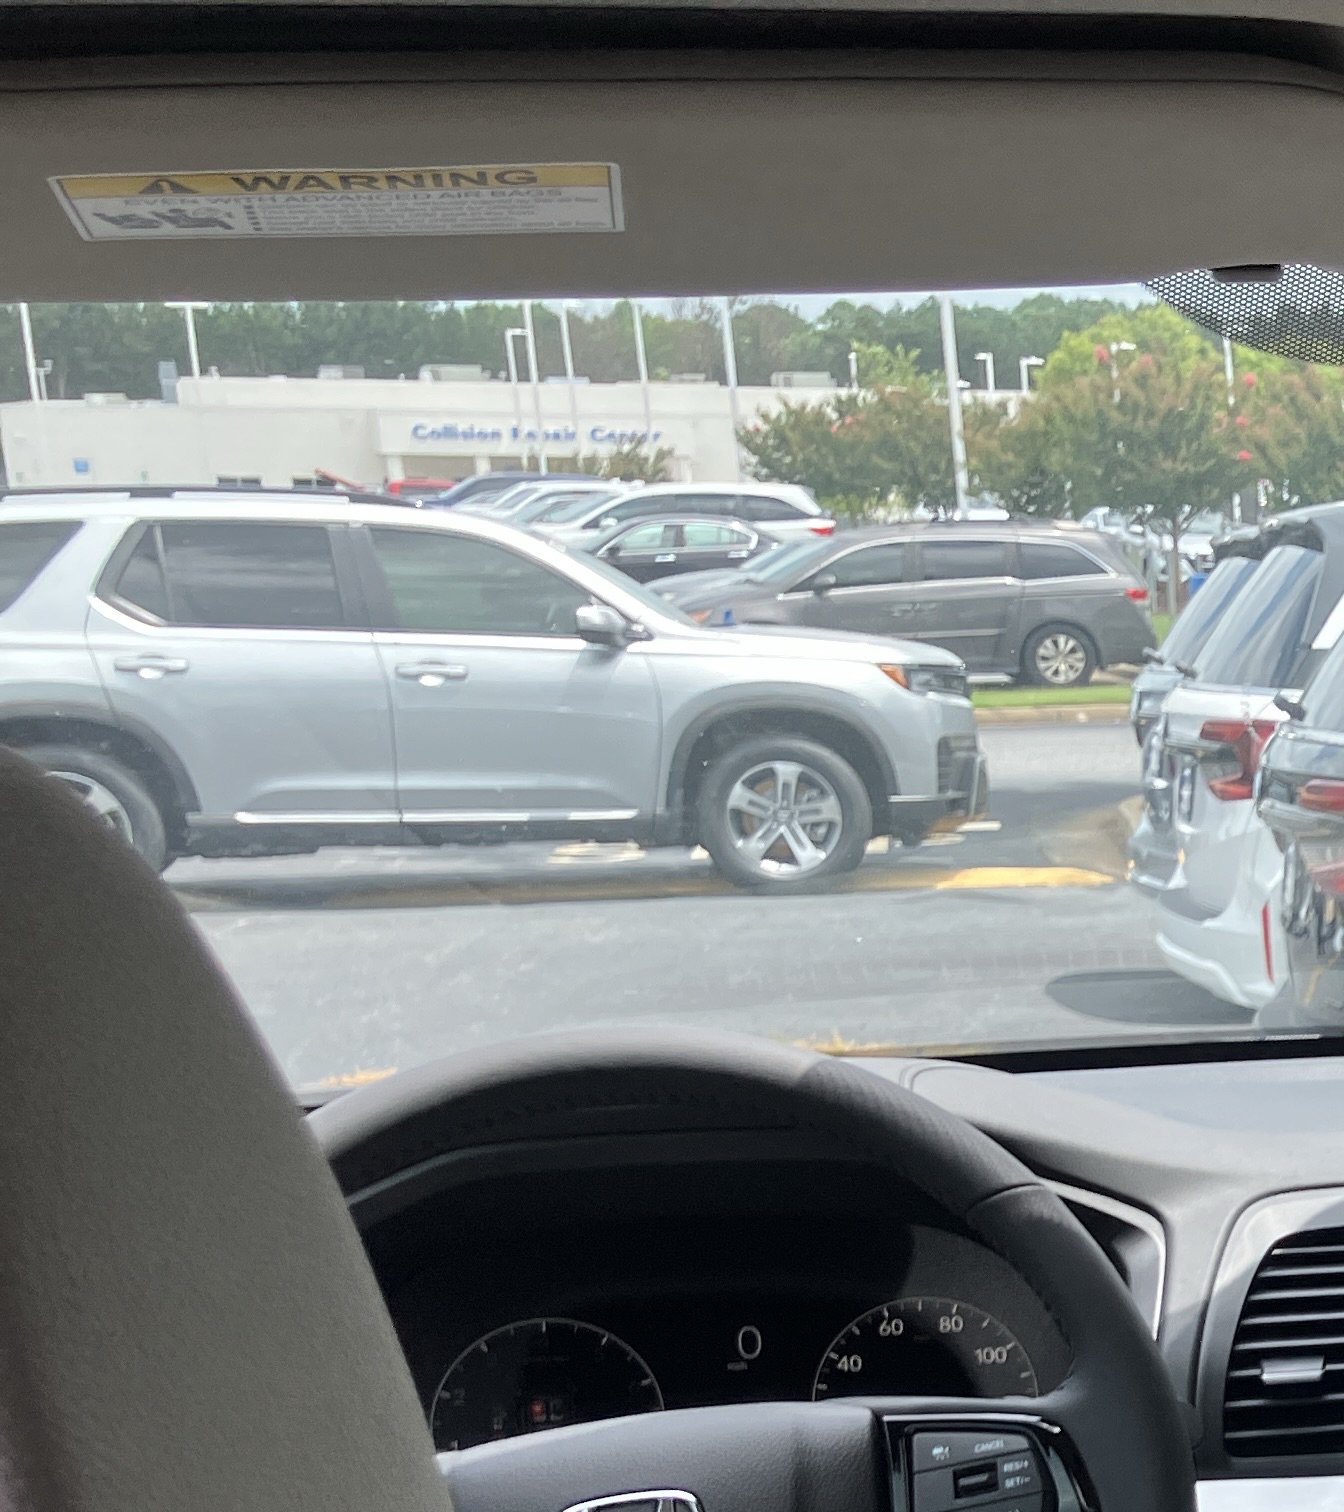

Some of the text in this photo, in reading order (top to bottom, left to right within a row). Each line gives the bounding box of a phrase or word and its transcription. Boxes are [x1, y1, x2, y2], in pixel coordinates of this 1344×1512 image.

[231, 170, 538, 192] WARNING
[411, 423, 502, 442] Collision
[879, 1317, 904, 1337] 60
[938, 1314, 964, 1334] 80
[737, 1325, 762, 1360] 0
[837, 1354, 863, 1374] 40
[973, 1345, 1008, 1366] 100
